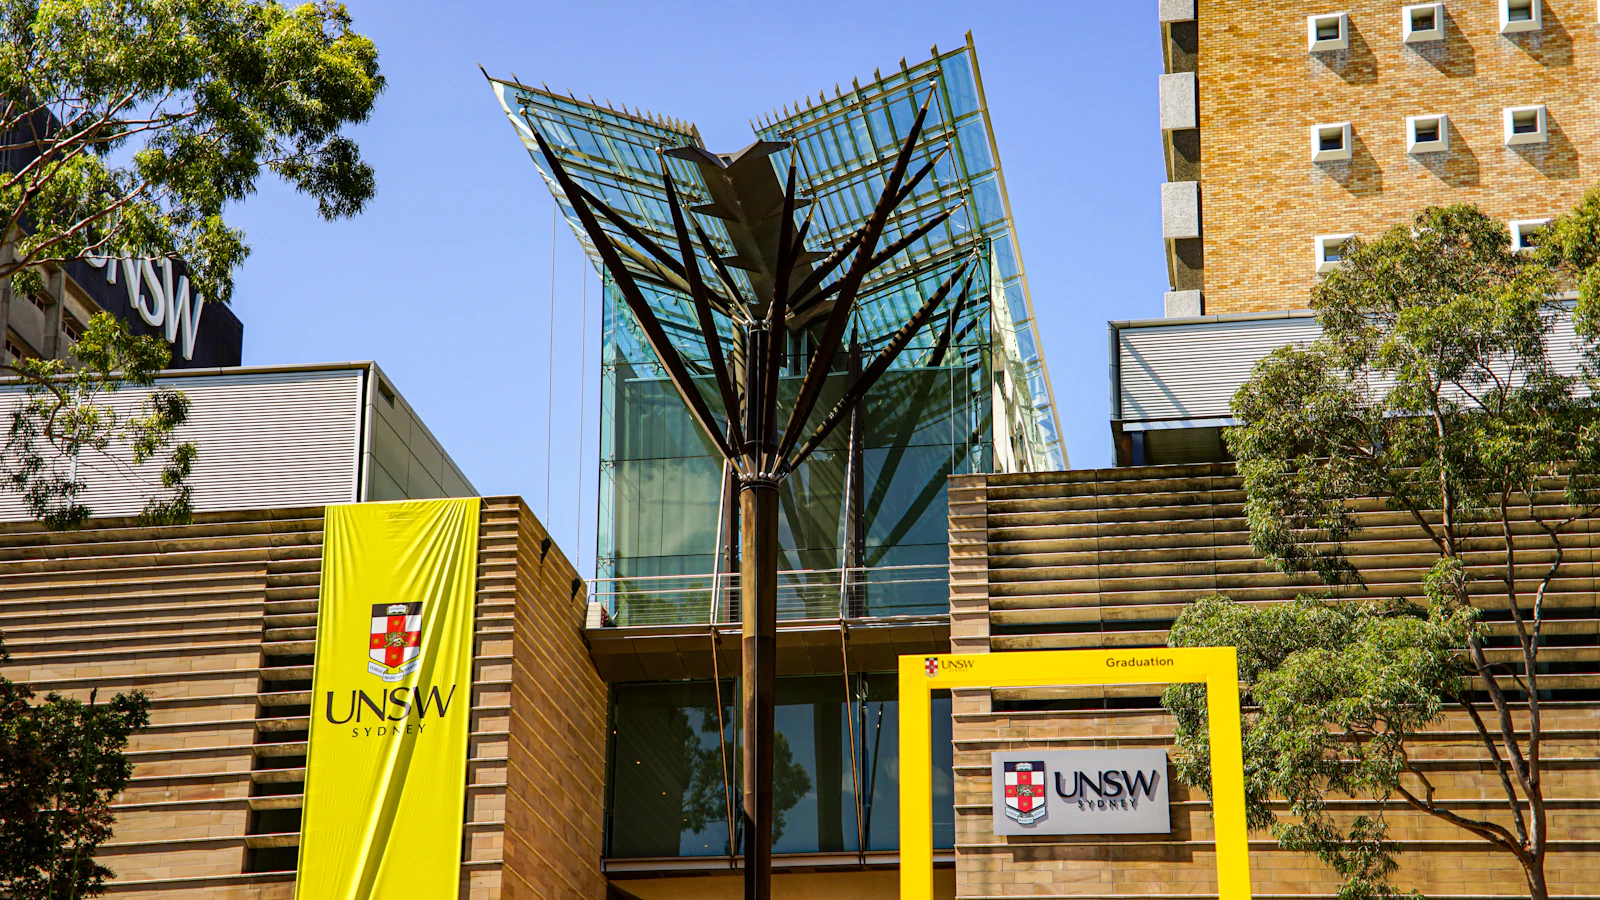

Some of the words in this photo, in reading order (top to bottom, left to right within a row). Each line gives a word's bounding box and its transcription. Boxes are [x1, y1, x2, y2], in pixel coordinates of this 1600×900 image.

[941, 659, 975, 669] UNSW
[1106, 657, 1174, 667] Graduation
[326, 684, 457, 725] UNSW
[352, 723, 426, 738] SYDNEY
[1054, 769, 1157, 798] UNSW
[1077, 799, 1137, 808] SYDNEY
